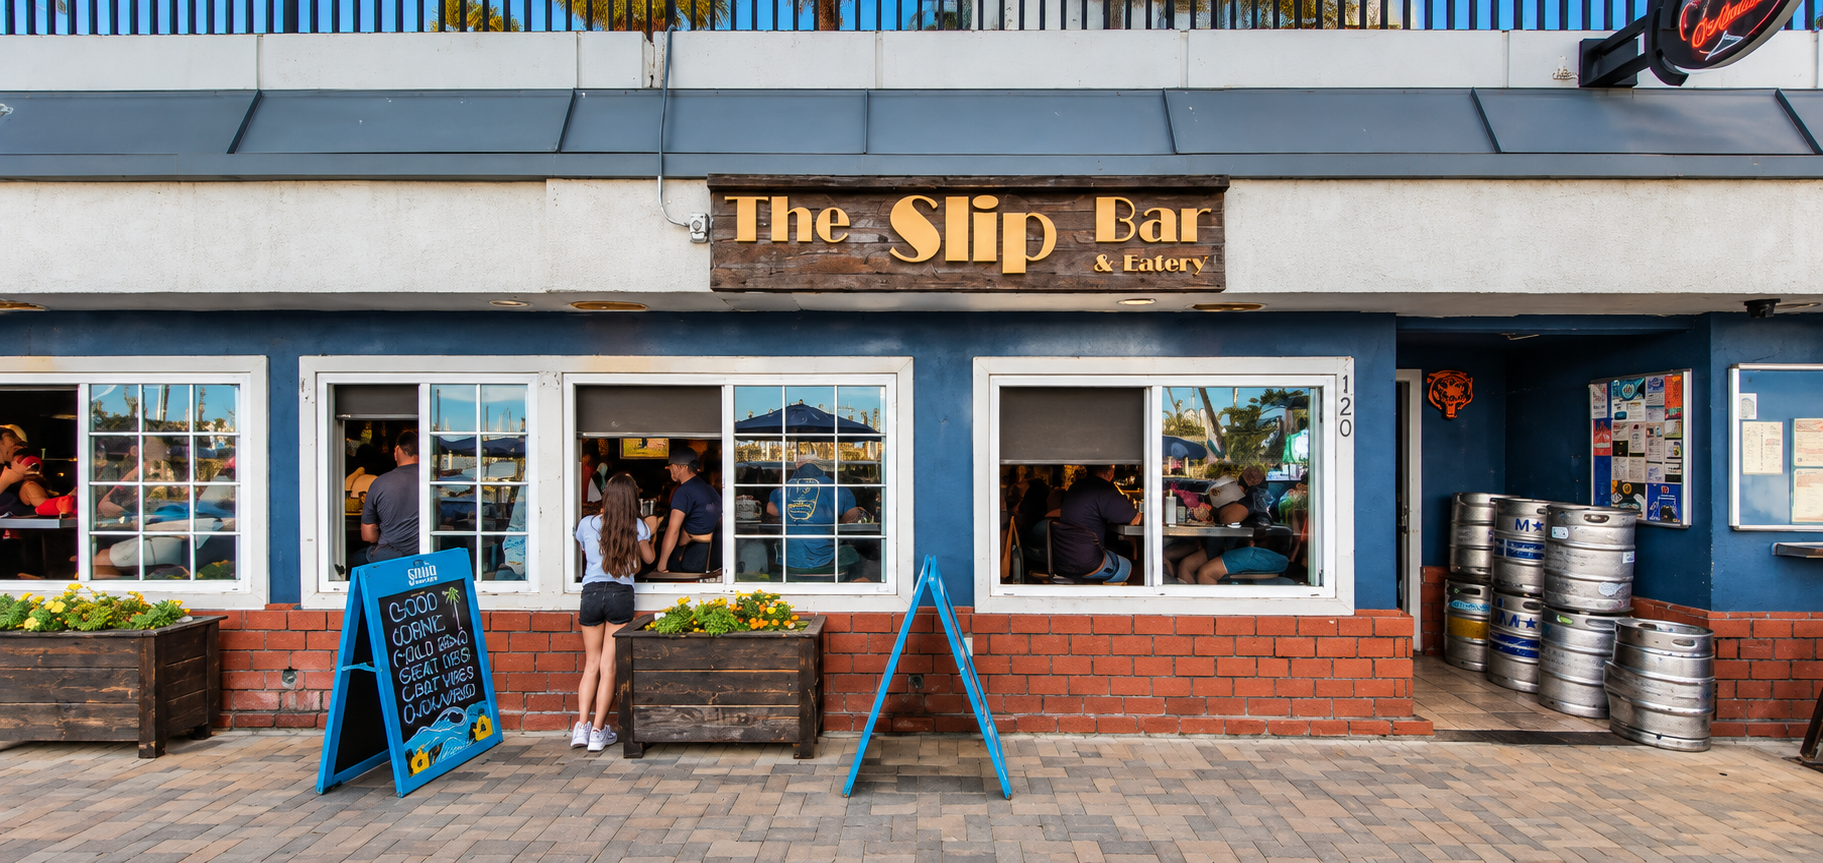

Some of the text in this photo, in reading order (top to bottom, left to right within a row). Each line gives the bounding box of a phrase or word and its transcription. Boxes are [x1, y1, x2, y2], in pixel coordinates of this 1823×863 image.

[724, 195, 1212, 274] The Slip Bar
[1093, 253, 1209, 276] & Eatery
